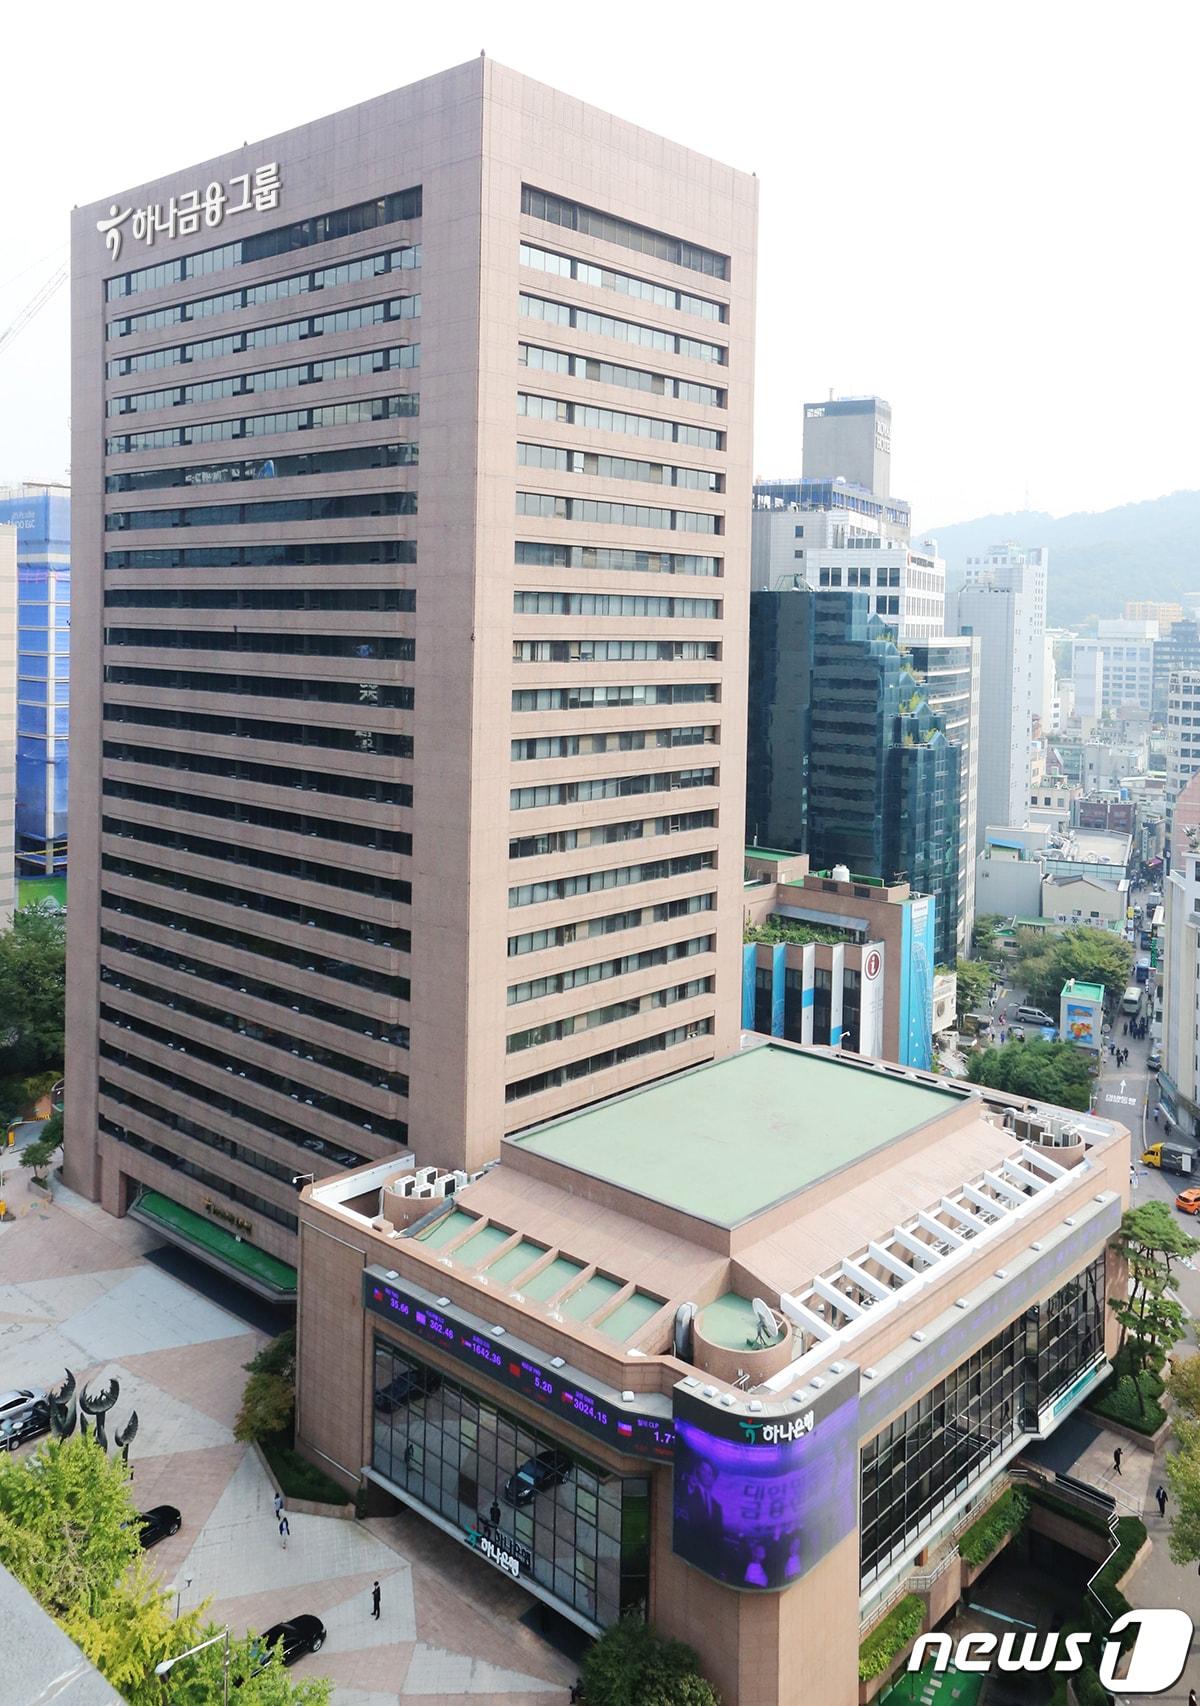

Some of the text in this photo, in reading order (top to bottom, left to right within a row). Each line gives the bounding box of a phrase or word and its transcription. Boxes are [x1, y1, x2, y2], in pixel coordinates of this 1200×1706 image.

[133, 162, 282, 246] 하나금융그룹
[534, 1376, 553, 1394] 5.20
[573, 1398, 607, 1425] 3024.15
[763, 1410, 814, 1444] 하나은행
[481, 1537, 519, 1577] 하나은행
